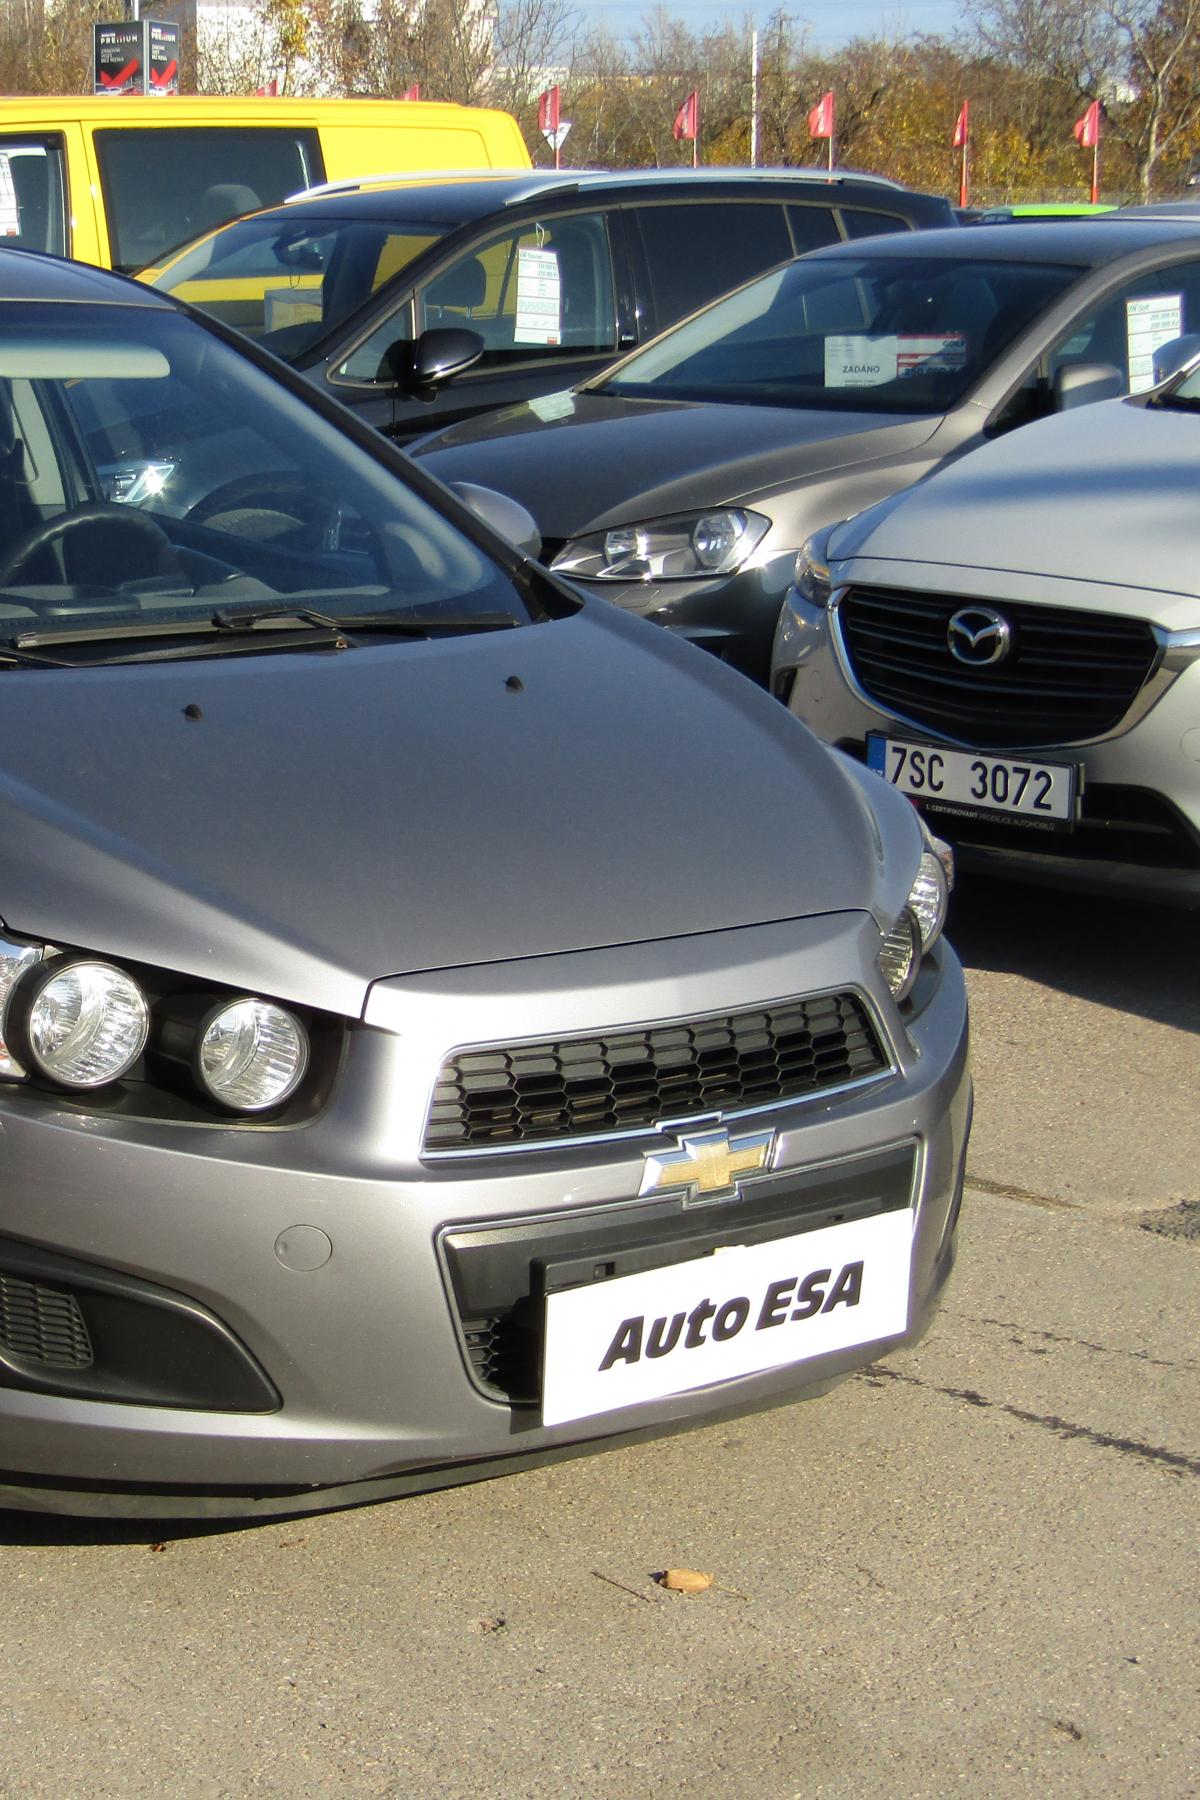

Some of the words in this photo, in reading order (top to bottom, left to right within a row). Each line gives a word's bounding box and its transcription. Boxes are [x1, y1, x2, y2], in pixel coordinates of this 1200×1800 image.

[100, 34, 138, 44] PREMIUM
[842, 363, 880, 373] ZADÁNO
[892, 746, 944, 792] 7SC
[970, 761, 1052, 811] 3072
[598, 1296, 750, 1371] Auto
[755, 1260, 864, 1331] ESA
